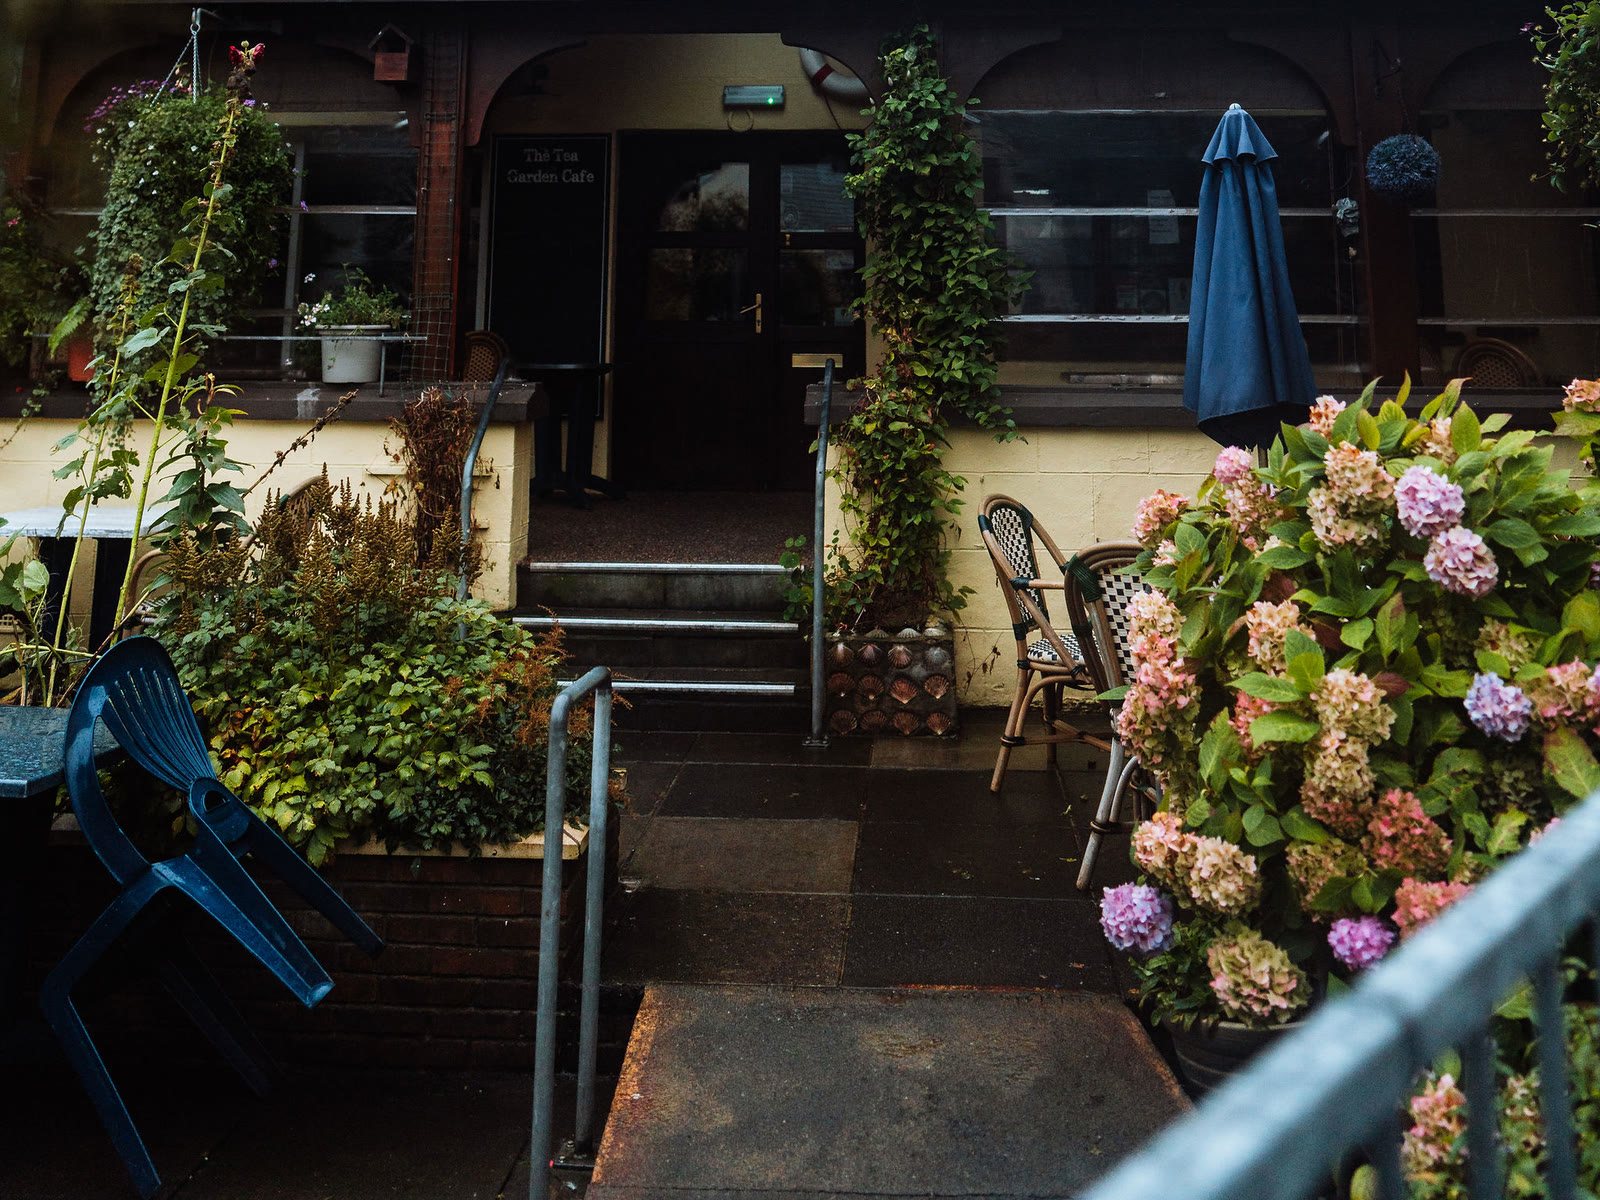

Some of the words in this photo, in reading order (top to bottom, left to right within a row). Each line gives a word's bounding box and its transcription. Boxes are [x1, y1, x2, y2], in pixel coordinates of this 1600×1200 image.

[522, 147, 551, 162] The
[553, 148, 579, 162] Tea
[507, 168, 559, 183] Garden
[561, 168, 595, 183] Cafe
